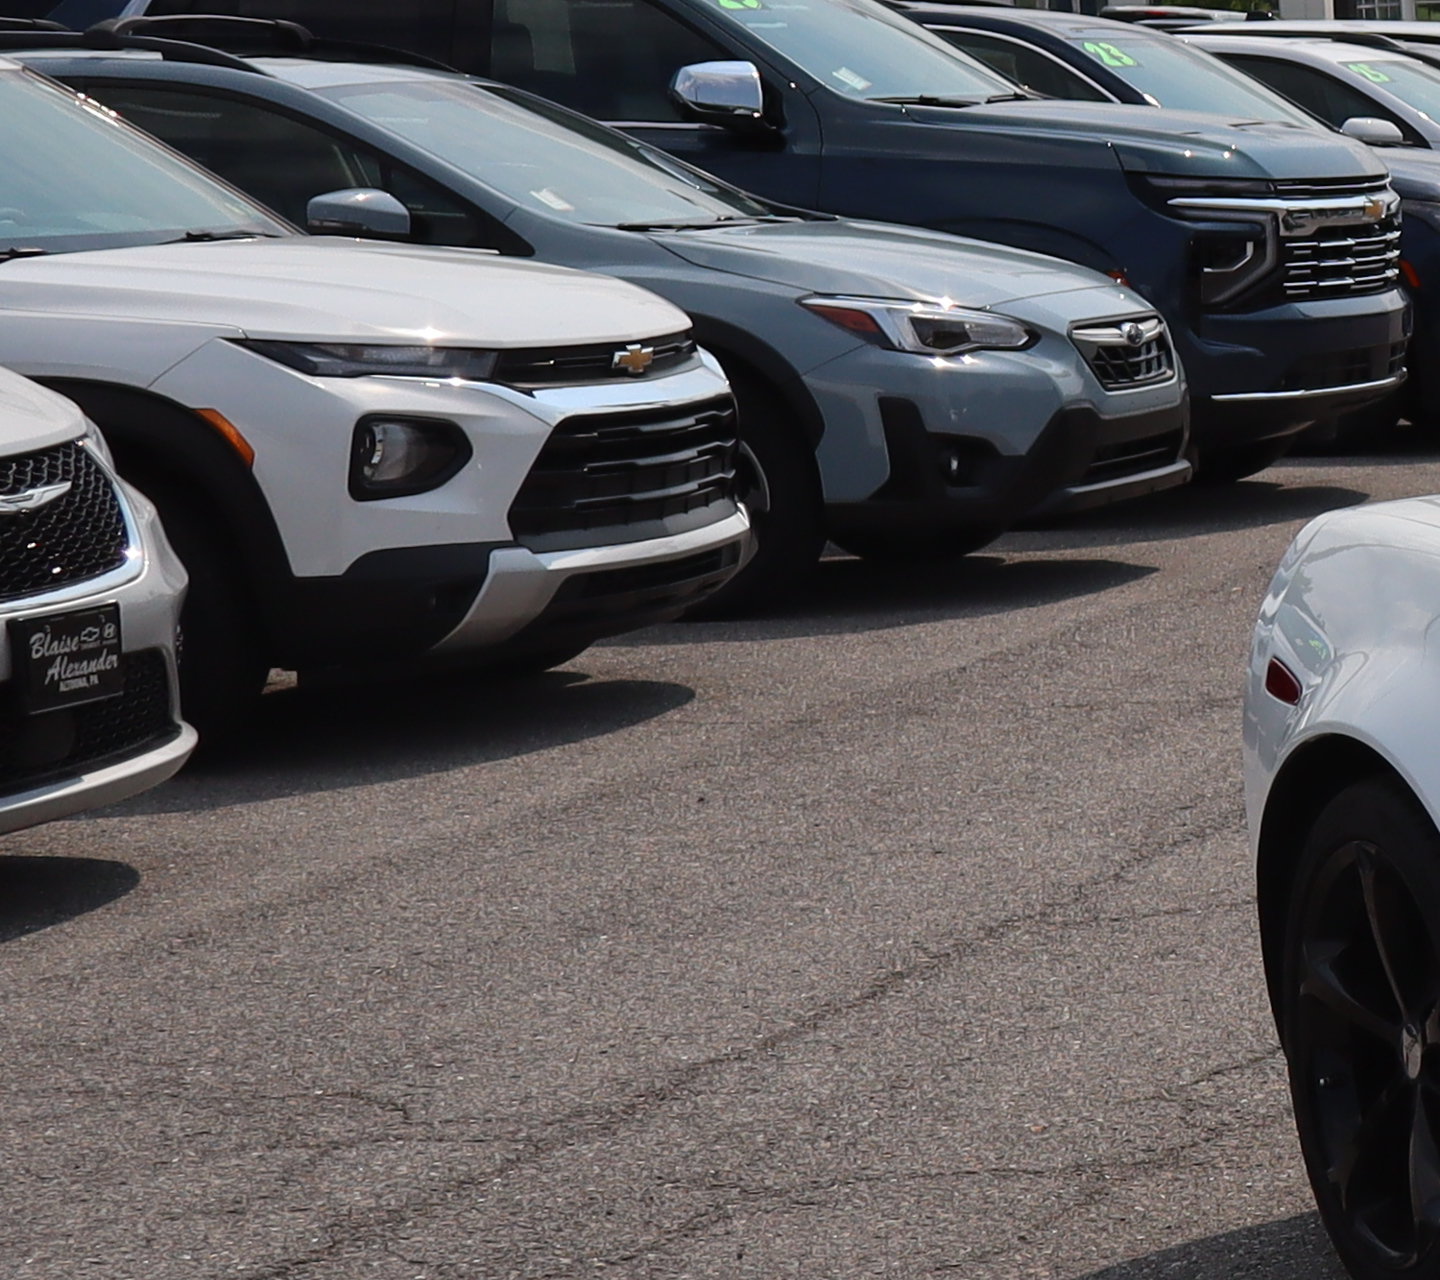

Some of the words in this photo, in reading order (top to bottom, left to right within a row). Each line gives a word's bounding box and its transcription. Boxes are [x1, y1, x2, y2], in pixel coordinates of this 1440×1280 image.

[1083, 42, 1138, 67] 23
[29, 631, 80, 660] Blaise
[44, 648, 118, 686] Alexander
